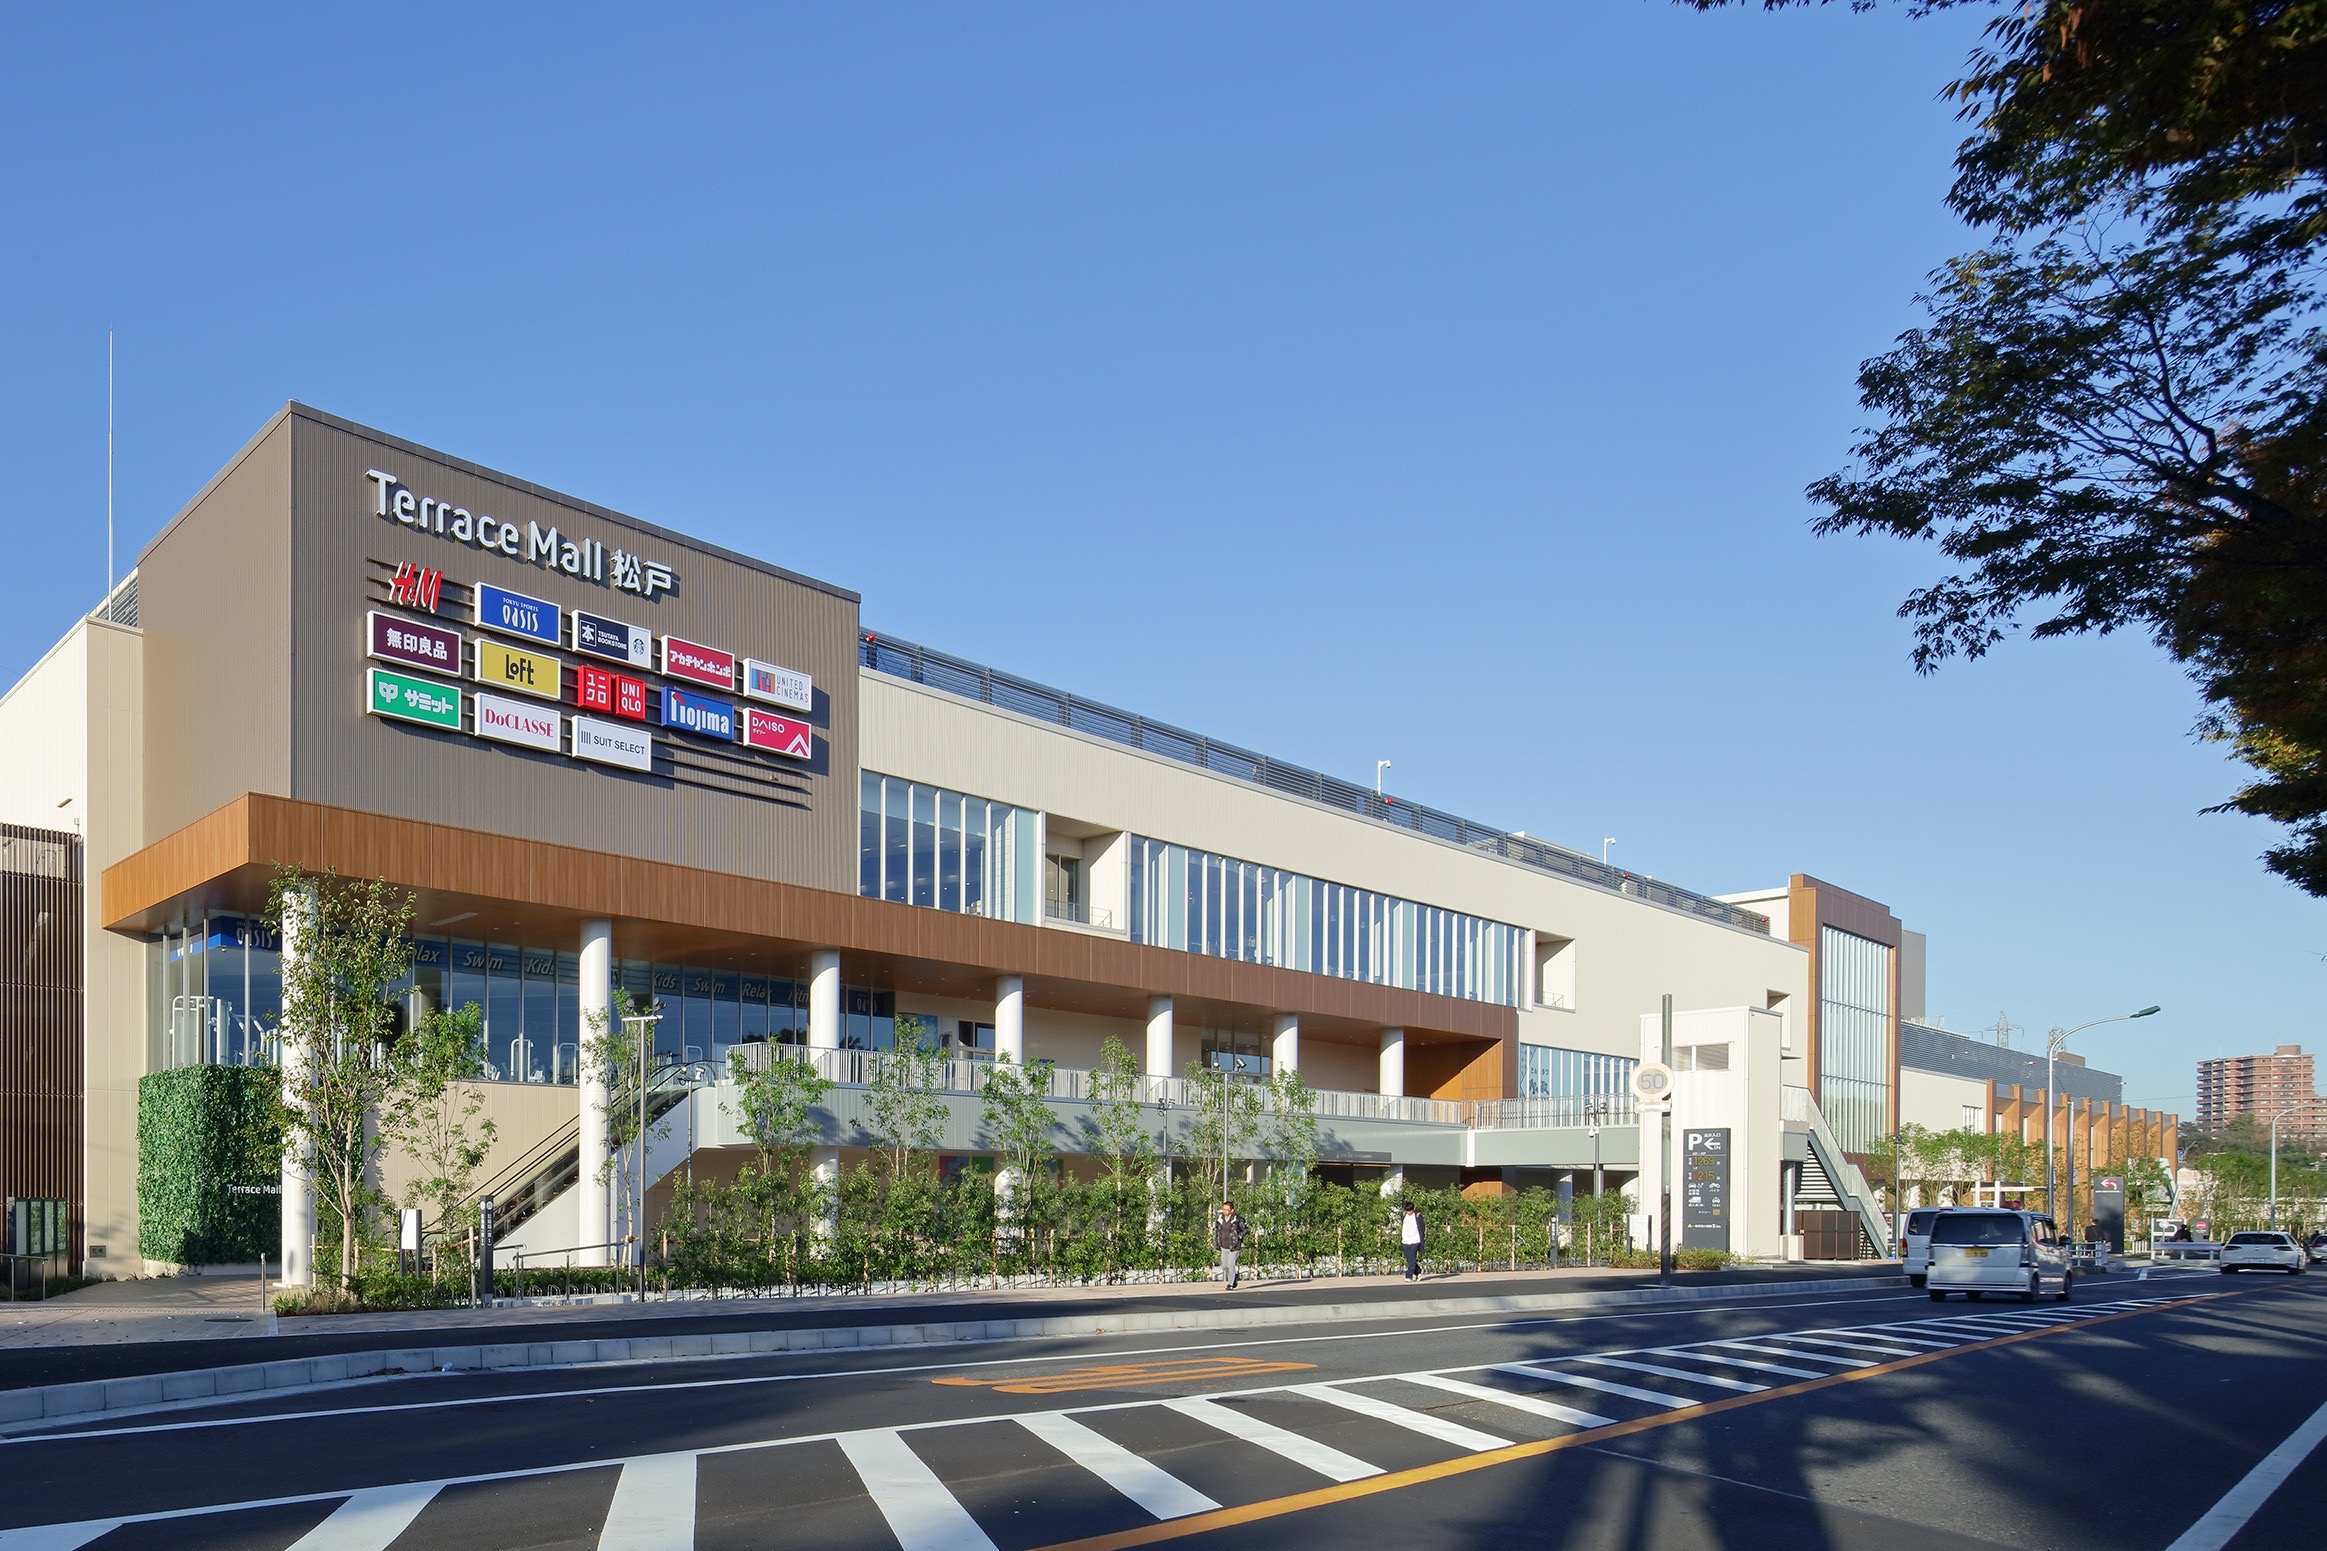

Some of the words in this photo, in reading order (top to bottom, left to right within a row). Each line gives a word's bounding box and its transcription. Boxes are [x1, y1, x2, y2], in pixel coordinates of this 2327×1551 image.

[365, 469, 519, 555] Terrace
[527, 520, 601, 581] Mall
[610, 548, 673, 597] 松戸
[388, 560, 442, 614] H&M
[502, 597, 520, 608] TOKYU
[520, 601, 539, 613] SPORTS
[581, 625, 595, 642] 本
[597, 630, 619, 642] TSUTAYA
[386, 627, 448, 661] 無印良品
[597, 637, 627, 650] BOOKSTORE
[668, 650, 732, 678] アカチャンホンポ
[621, 681, 640, 697] UNI
[776, 675, 803, 691] UNITED
[404, 688, 454, 715] サミット
[776, 686, 809, 703] CINEMAS
[621, 696, 642, 712] QLO
[671, 691, 730, 735] nojima
[485, 708, 554, 738] DoCLASSE
[752, 716, 785, 734] DAISO
[593, 735, 612, 748] SUIT
[614, 739, 646, 756] SELECT
[652, 972, 677, 989] Kids
[1641, 1073, 1664, 1090] 50
[1688, 1133, 1703, 1150] P
[226, 1184, 261, 1194] Terrace
[262, 1184, 282, 1194] Mall
